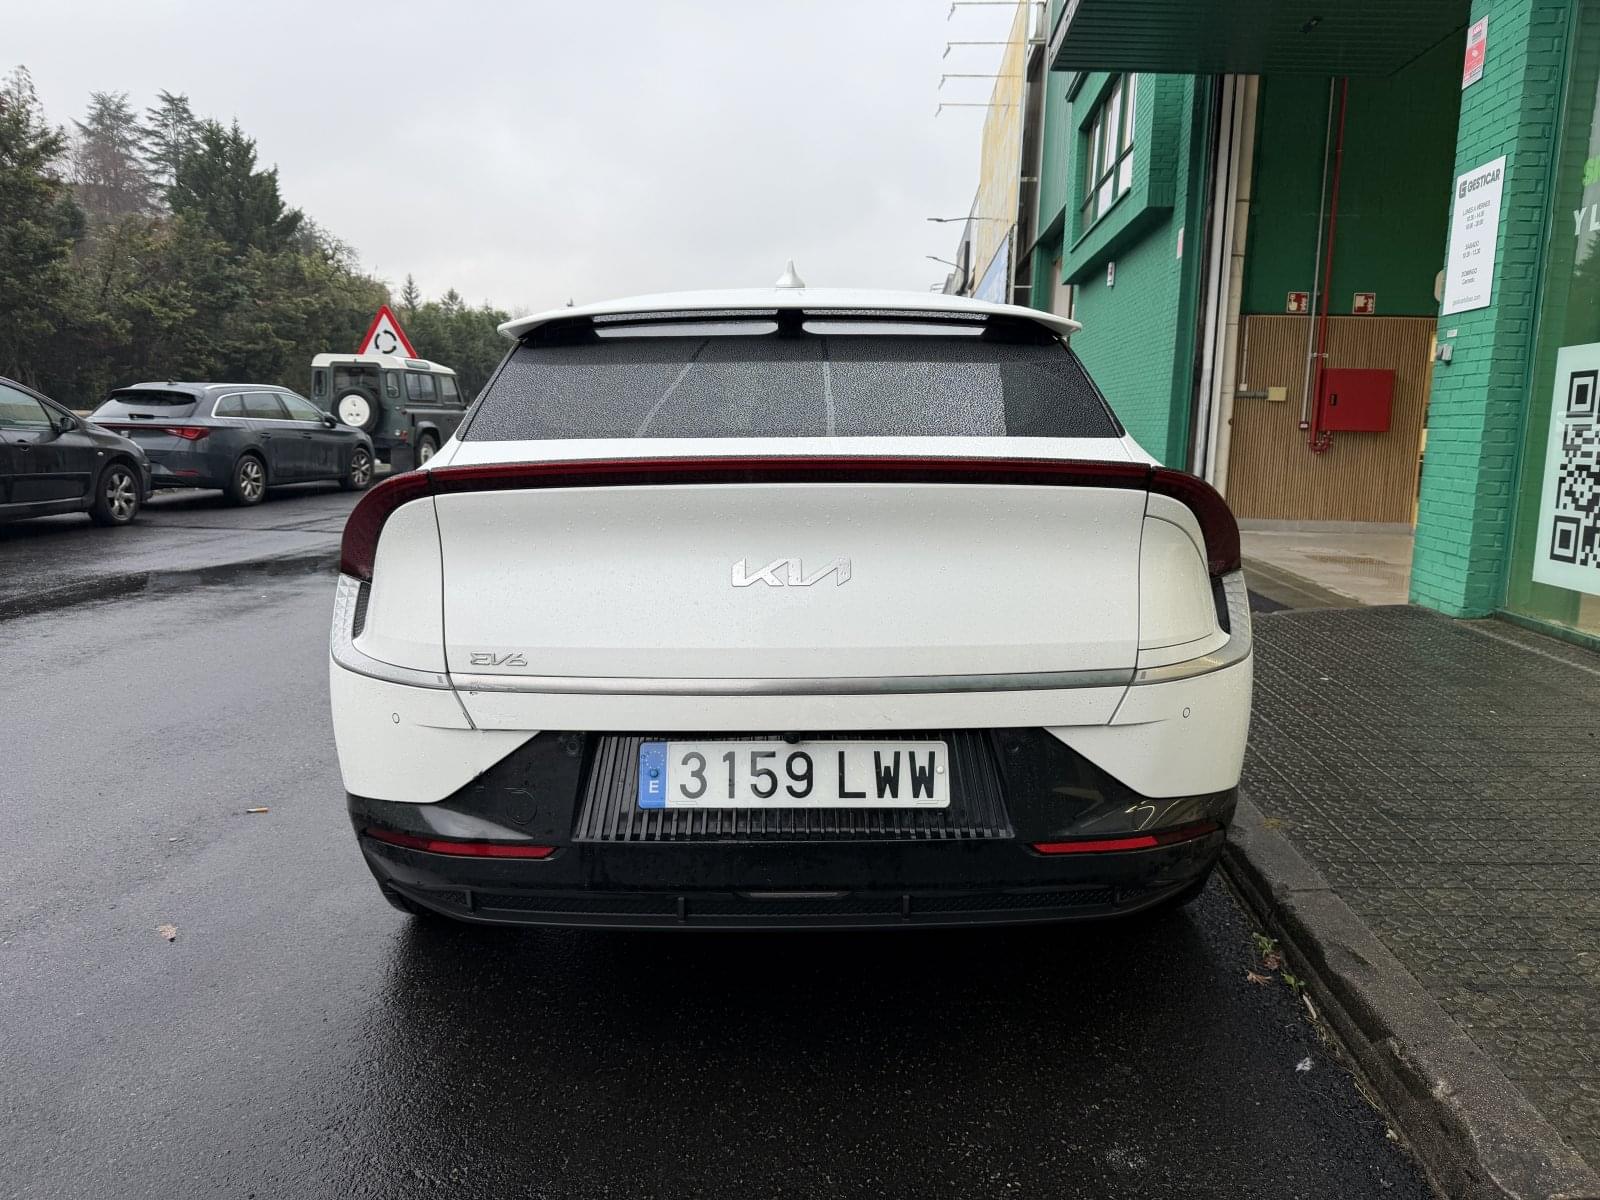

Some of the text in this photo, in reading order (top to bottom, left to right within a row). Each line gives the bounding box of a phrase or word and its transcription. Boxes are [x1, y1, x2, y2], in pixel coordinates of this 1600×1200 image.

[1467, 168, 1501, 192] GESTICAR
[731, 556, 852, 588] KIA
[470, 651, 528, 667] EV6
[649, 780, 660, 794] E
[680, 751, 936, 799] 3159 LWW
